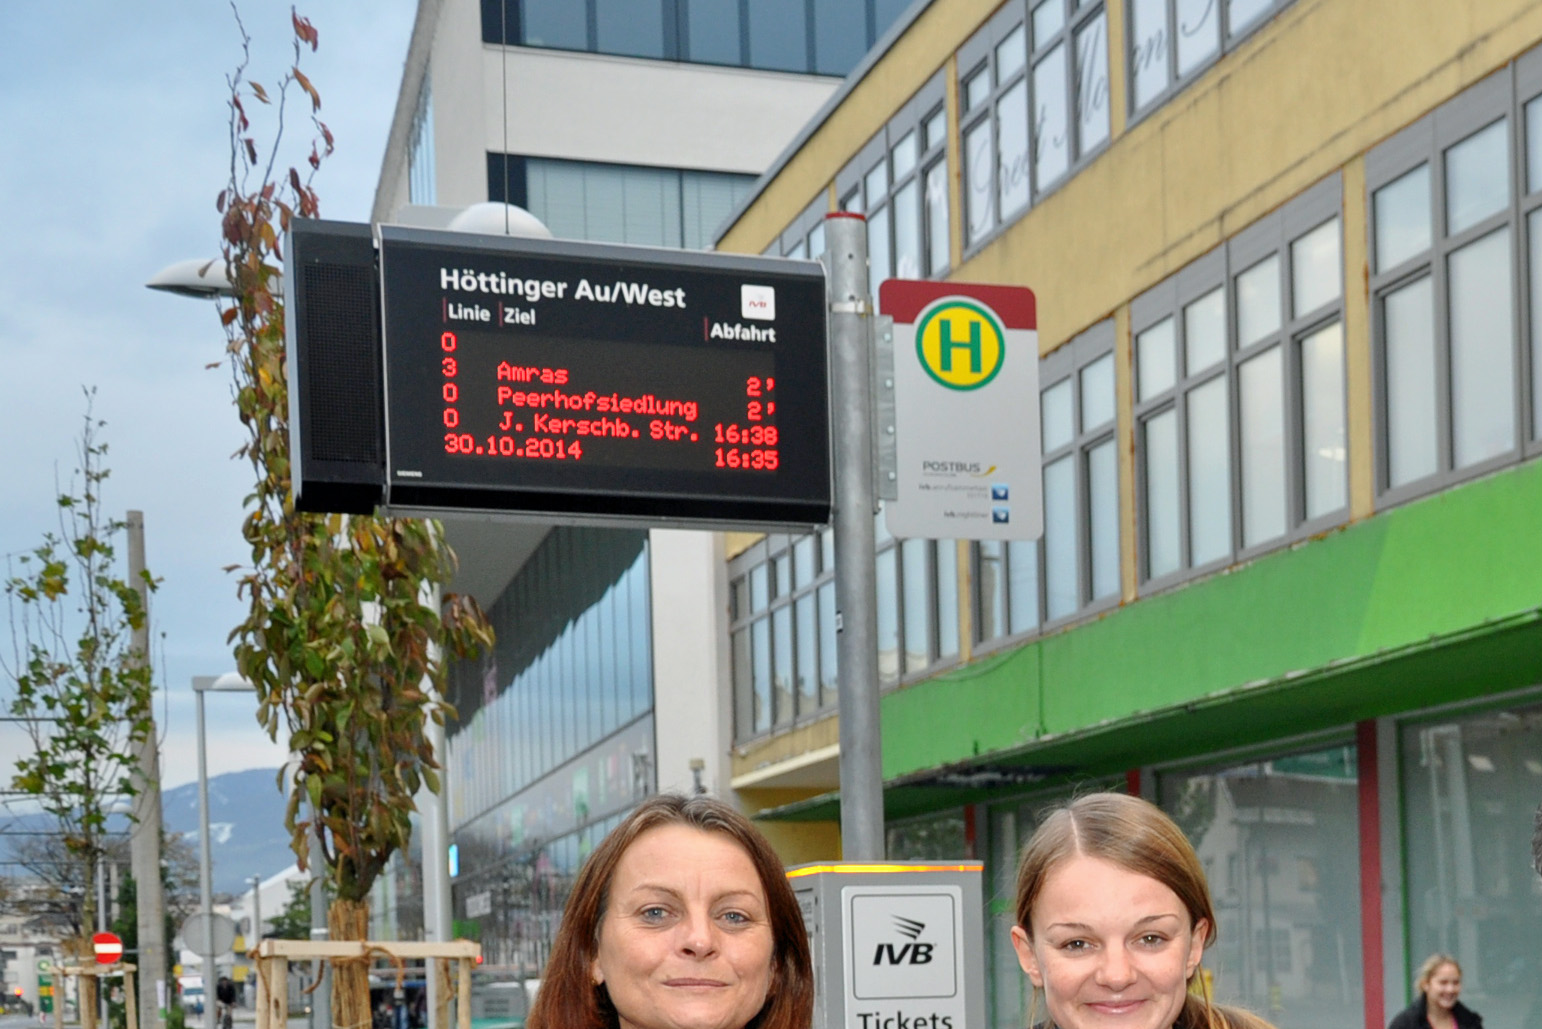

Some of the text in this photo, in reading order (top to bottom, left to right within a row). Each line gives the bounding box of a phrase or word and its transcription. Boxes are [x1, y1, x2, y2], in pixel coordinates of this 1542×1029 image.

[440, 268, 687, 309] Höttinger Au/West
[448, 303, 536, 325] Linie Ziel
[441, 331, 457, 352] 0
[710, 323, 776, 343] Abfahrt
[939, 319, 982, 373] H
[442, 357, 457, 377] 3
[497, 360, 569, 385] Amras
[442, 382, 458, 403] 0
[497, 386, 699, 422] Peerhofsiedlung
[443, 407, 779, 446] 0 J. Kerschb. Str. 16:38
[444, 433, 779, 470] 30.10.2014 16:35
[923, 461, 981, 473] POSTBUS
[872, 943, 934, 965] IVB
